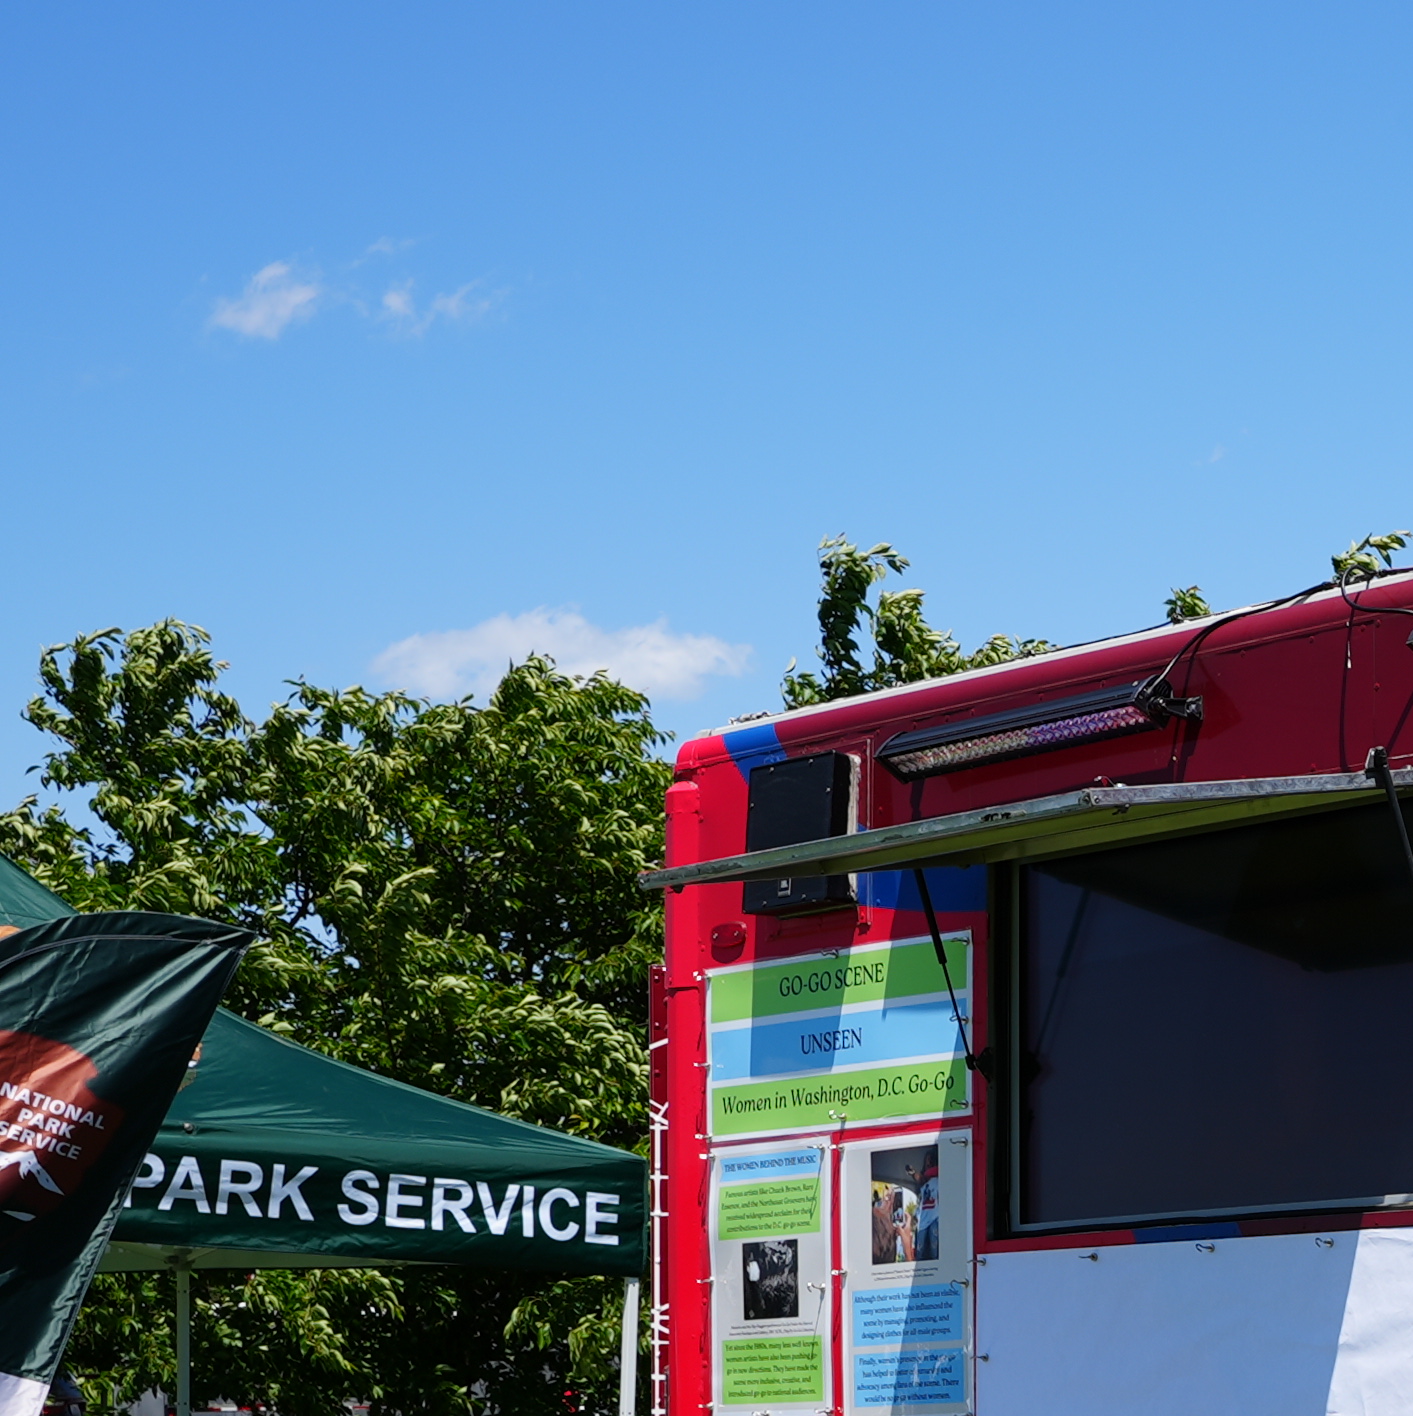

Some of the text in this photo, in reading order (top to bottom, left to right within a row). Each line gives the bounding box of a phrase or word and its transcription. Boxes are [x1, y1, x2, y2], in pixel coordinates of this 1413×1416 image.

[779, 962, 885, 998] GO-GO SCENE
[800, 1027, 863, 1055] UNSEEN
[0, 1081, 105, 1130] NATIONAL
[722, 1071, 955, 1115] Women in Washington, D.C. Go-Go
[0, 1121, 82, 1160] SERVICE
[17, 1107, 76, 1139] PARK
[724, 1164, 736, 1173] THE
[760, 1158, 784, 1169] BEHIND
[123, 1152, 620, 1246] PARK SERVICE
